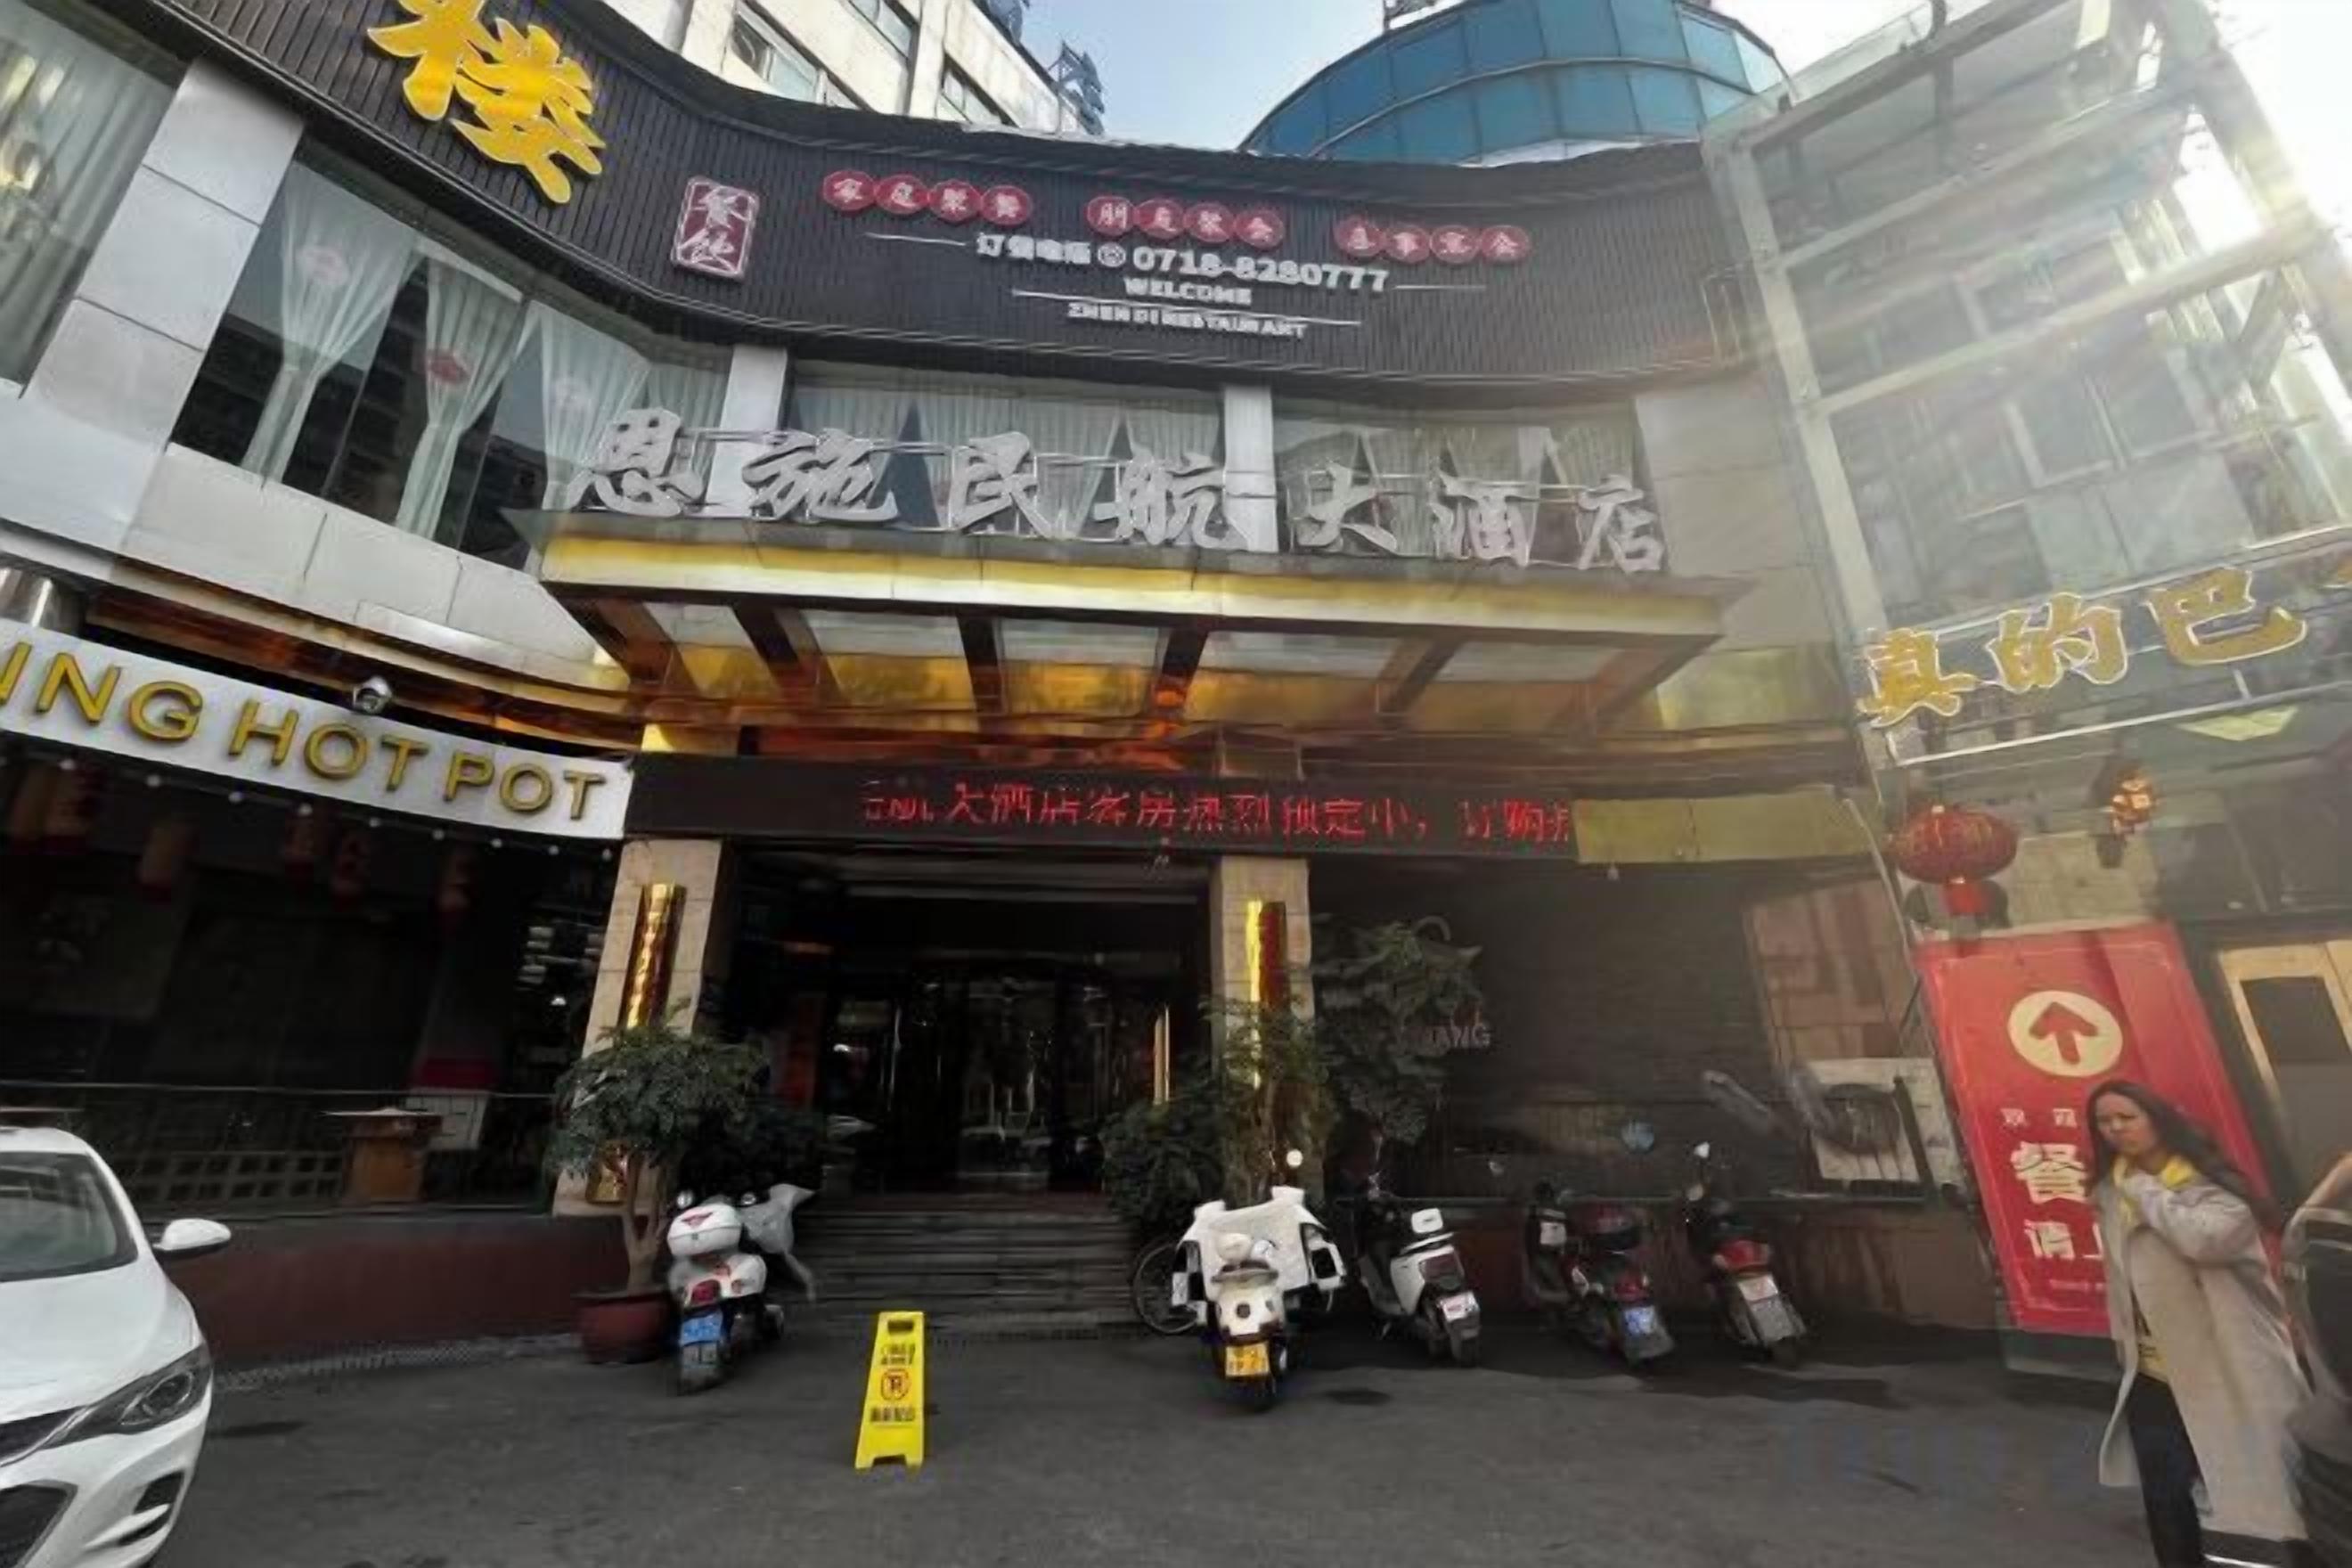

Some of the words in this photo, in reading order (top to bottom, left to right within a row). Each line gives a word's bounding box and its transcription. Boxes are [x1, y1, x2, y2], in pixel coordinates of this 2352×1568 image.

[1123, 277, 1252, 306] WELCOME
[568, 406, 1666, 574] 恩施民航大酒店
[1857, 554, 2352, 730] 真的巴
[228, 699, 429, 791] HOT
[445, 747, 607, 821] POT
